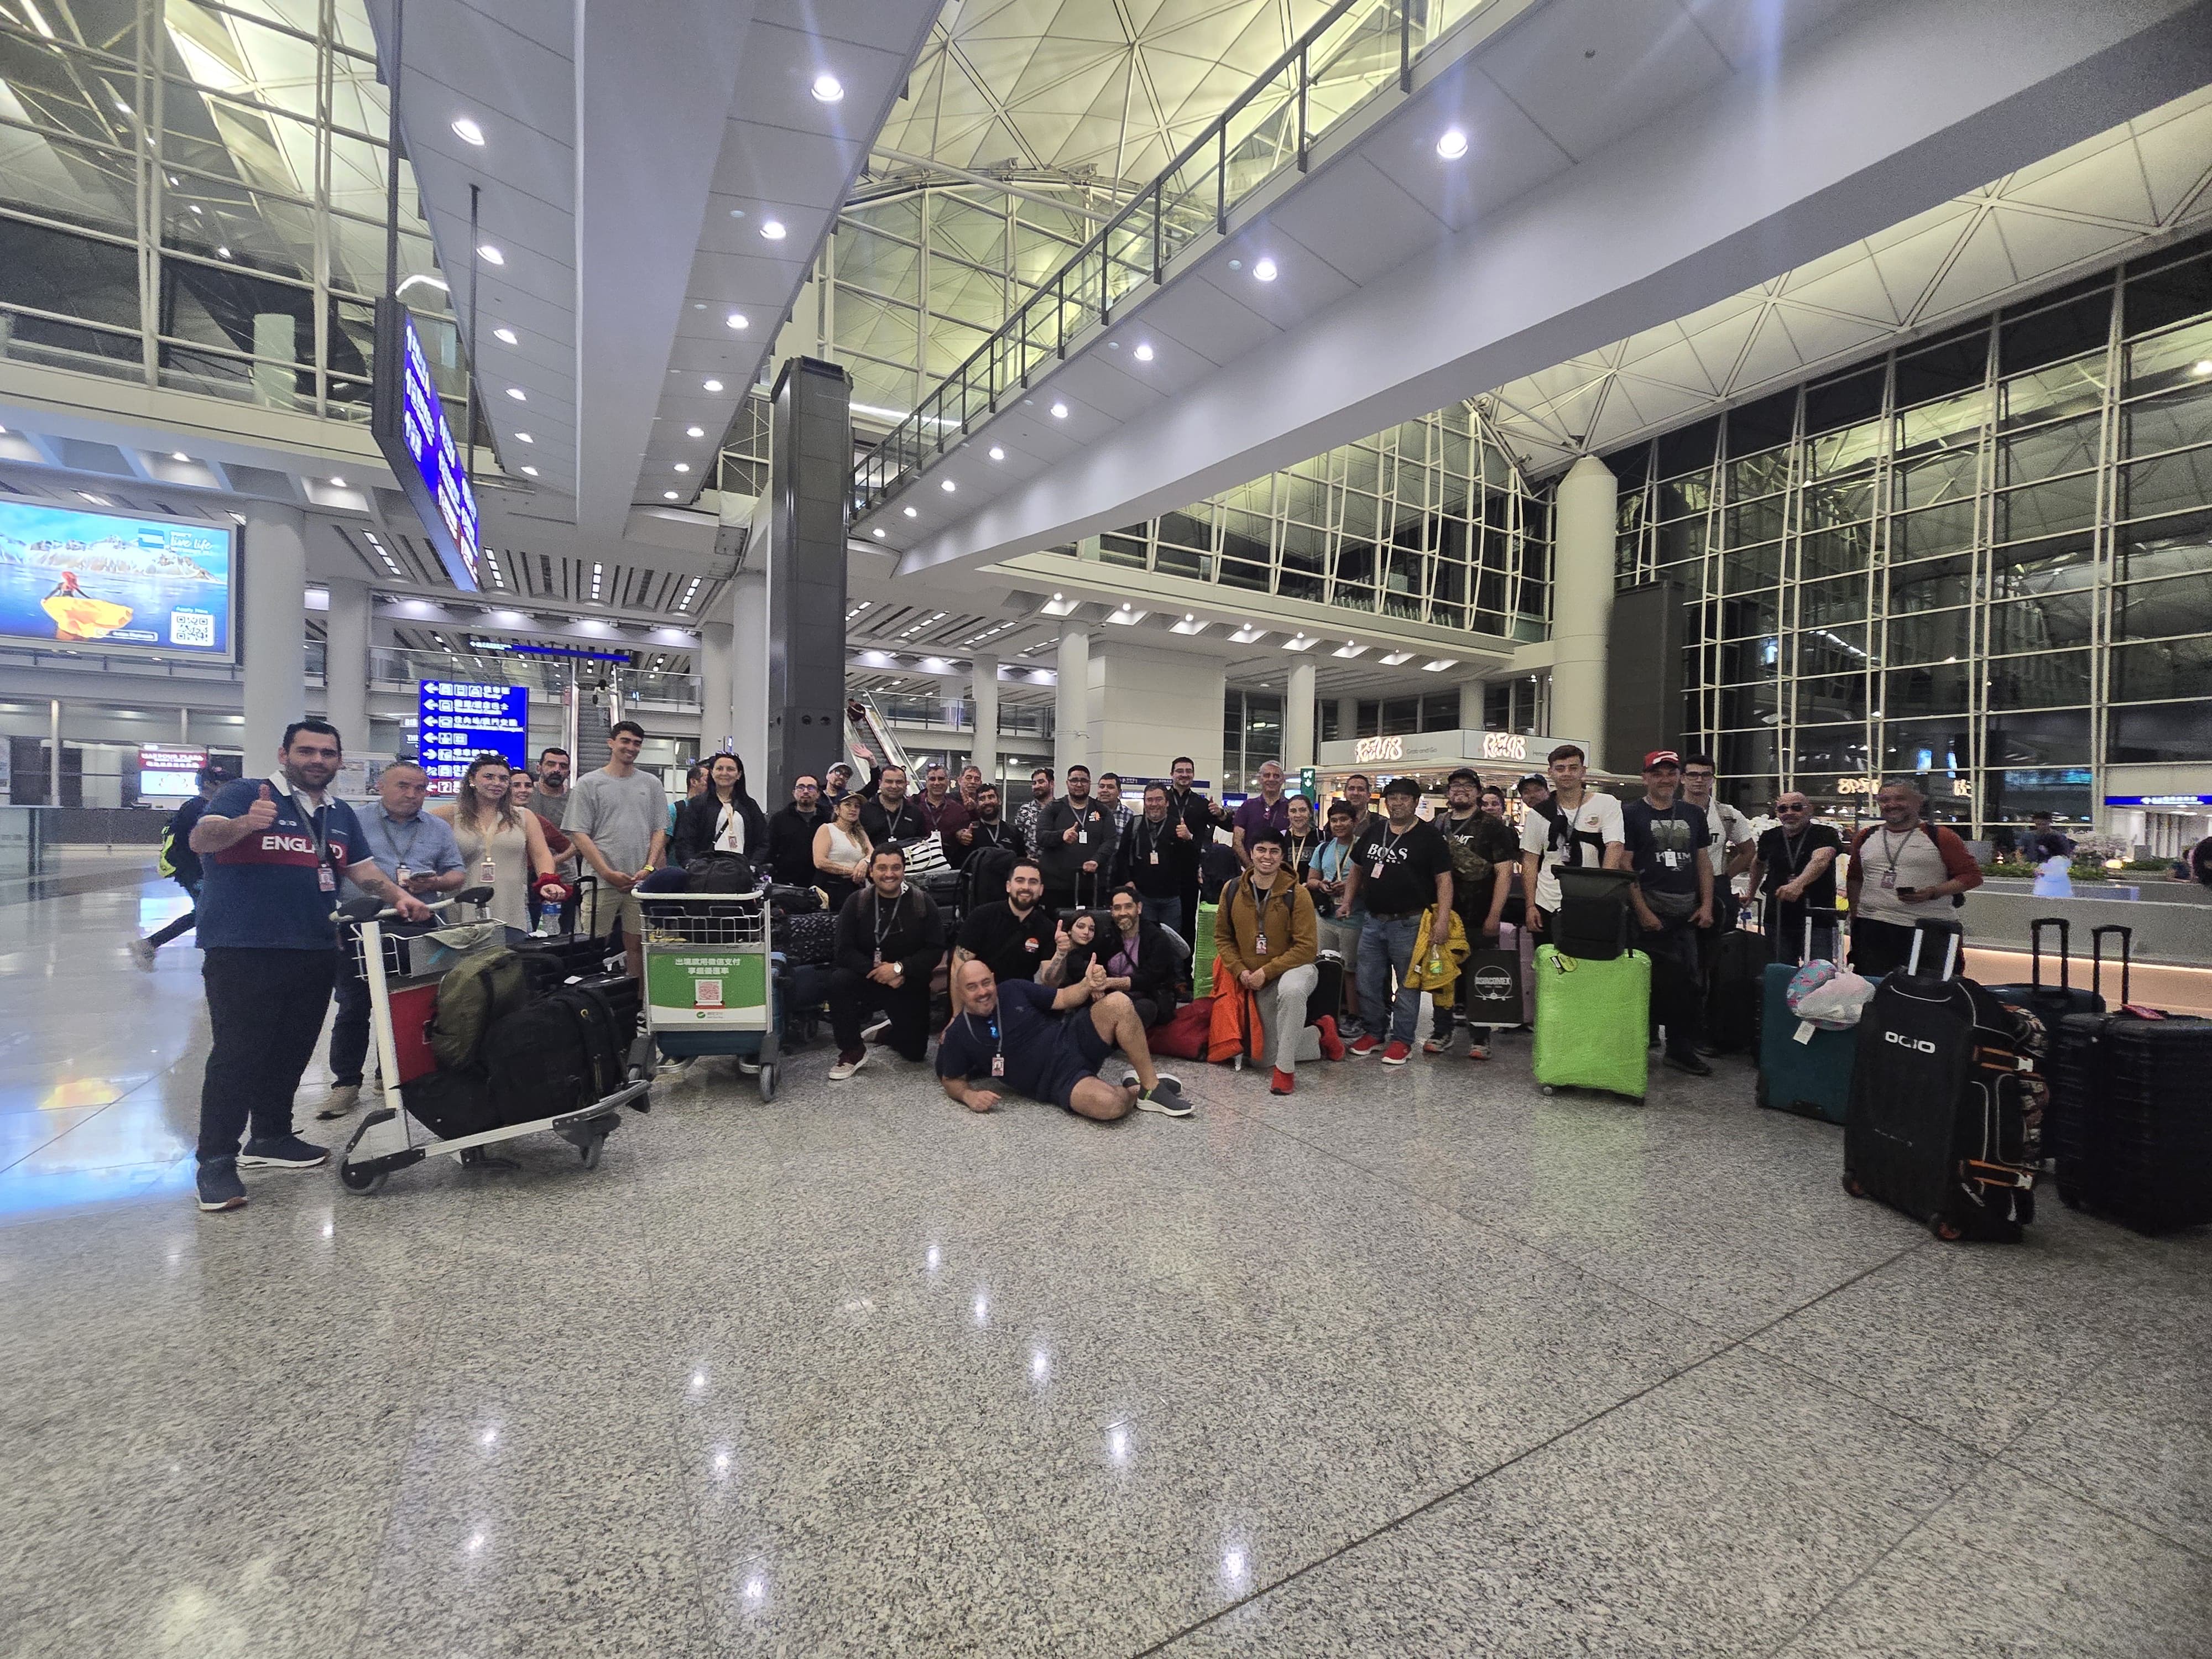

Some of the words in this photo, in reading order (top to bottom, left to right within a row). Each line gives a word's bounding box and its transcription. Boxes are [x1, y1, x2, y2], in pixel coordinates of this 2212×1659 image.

[171, 536, 192, 547] live
[194, 539, 212, 550] life
[262, 836, 343, 859] ENGLD
[1655, 852, 1692, 863] KIM
